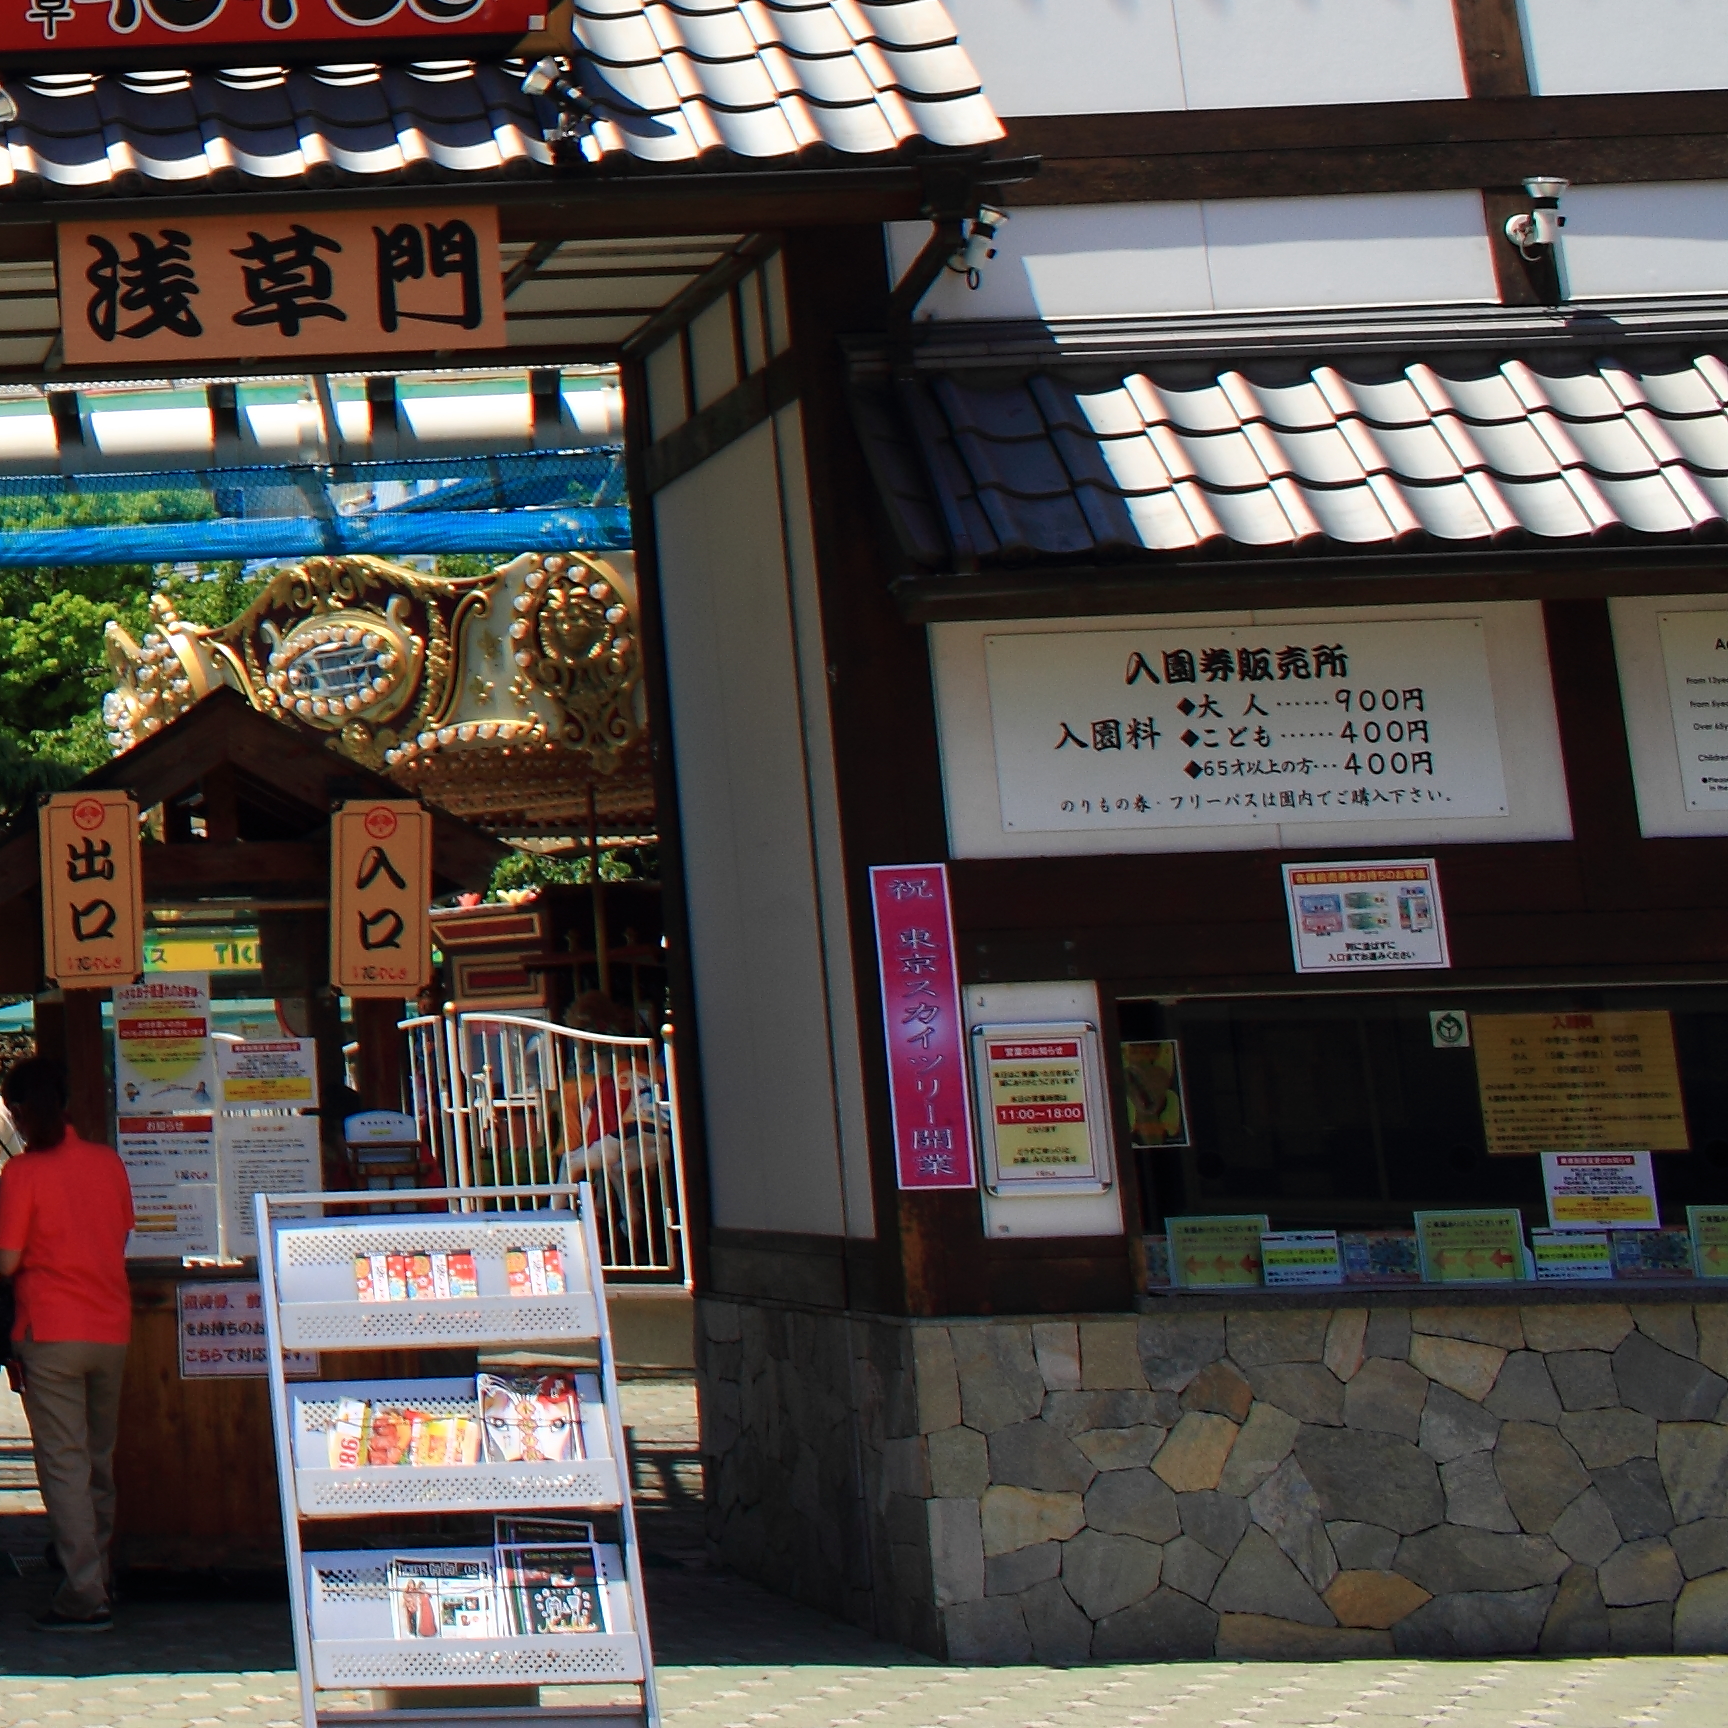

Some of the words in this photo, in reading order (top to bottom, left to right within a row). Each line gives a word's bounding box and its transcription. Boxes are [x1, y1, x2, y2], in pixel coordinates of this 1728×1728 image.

[86, 219, 483, 342] 浅草門
[1125, 644, 1350, 685] 入園券販売所
[1055, 718, 1161, 752] 入園料
[1203, 726, 1271, 749] こども
[67, 836, 117, 942] 出口
[355, 845, 407, 950] 入口
[898, 928, 954, 1176] 東京スカイツリー開業
